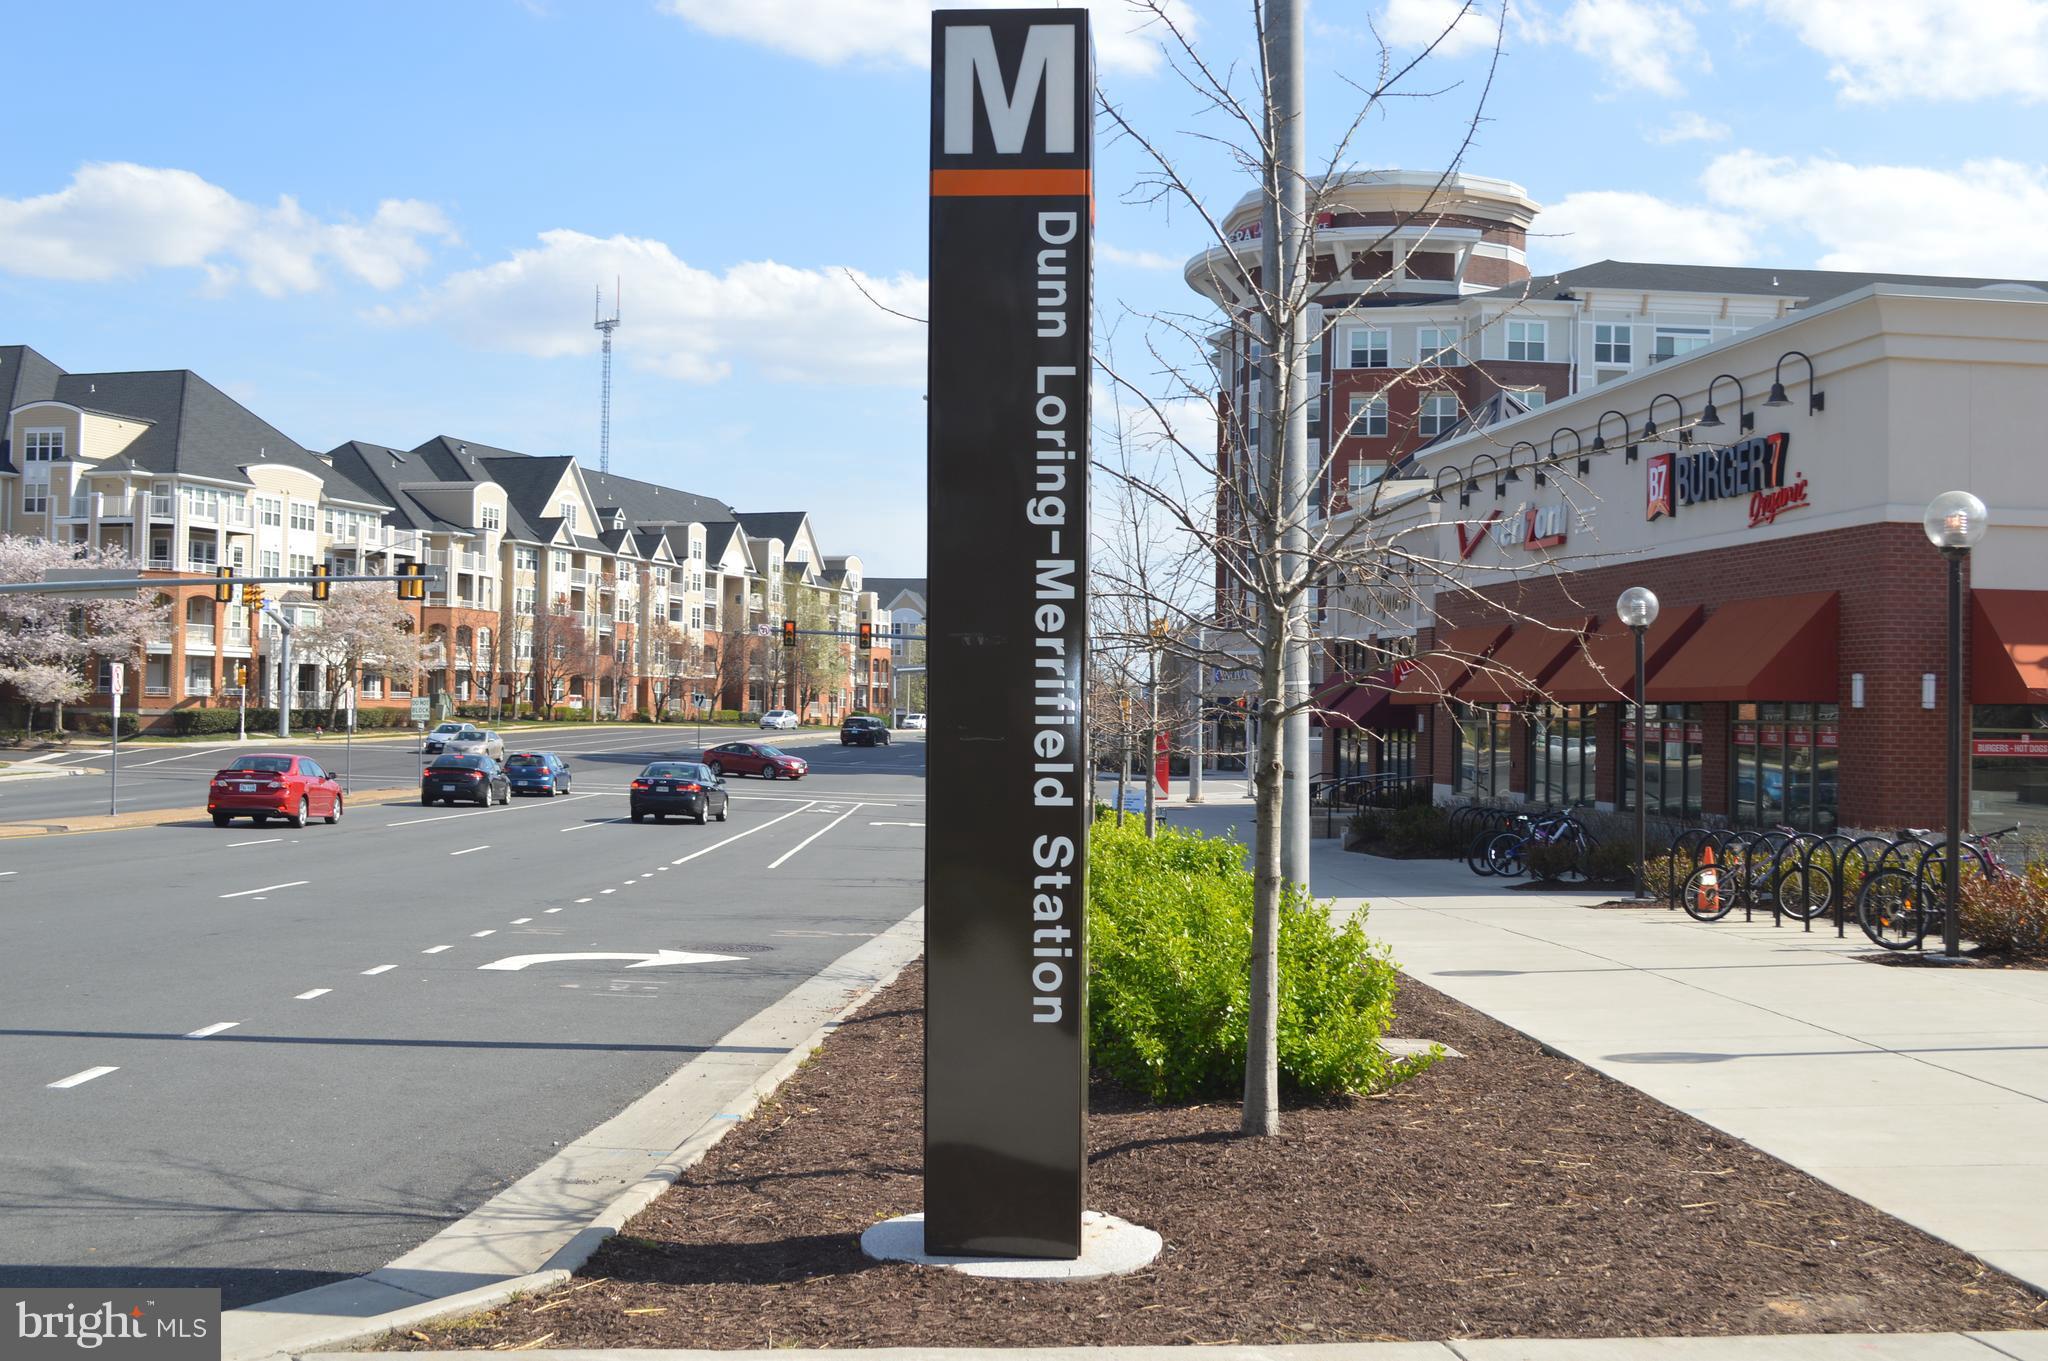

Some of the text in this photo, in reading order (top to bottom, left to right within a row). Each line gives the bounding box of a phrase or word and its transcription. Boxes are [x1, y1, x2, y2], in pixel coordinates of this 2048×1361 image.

[944, 24, 1075, 154] M
[1037, 212, 1077, 337] Dunn
[1649, 465, 1668, 501] B7
[1748, 472, 1809, 528] Organic
[1977, 743, 2009, 752] BURGERS
[2014, 744, 2029, 752] HOT
[1033, 835, 1075, 1023] Station
